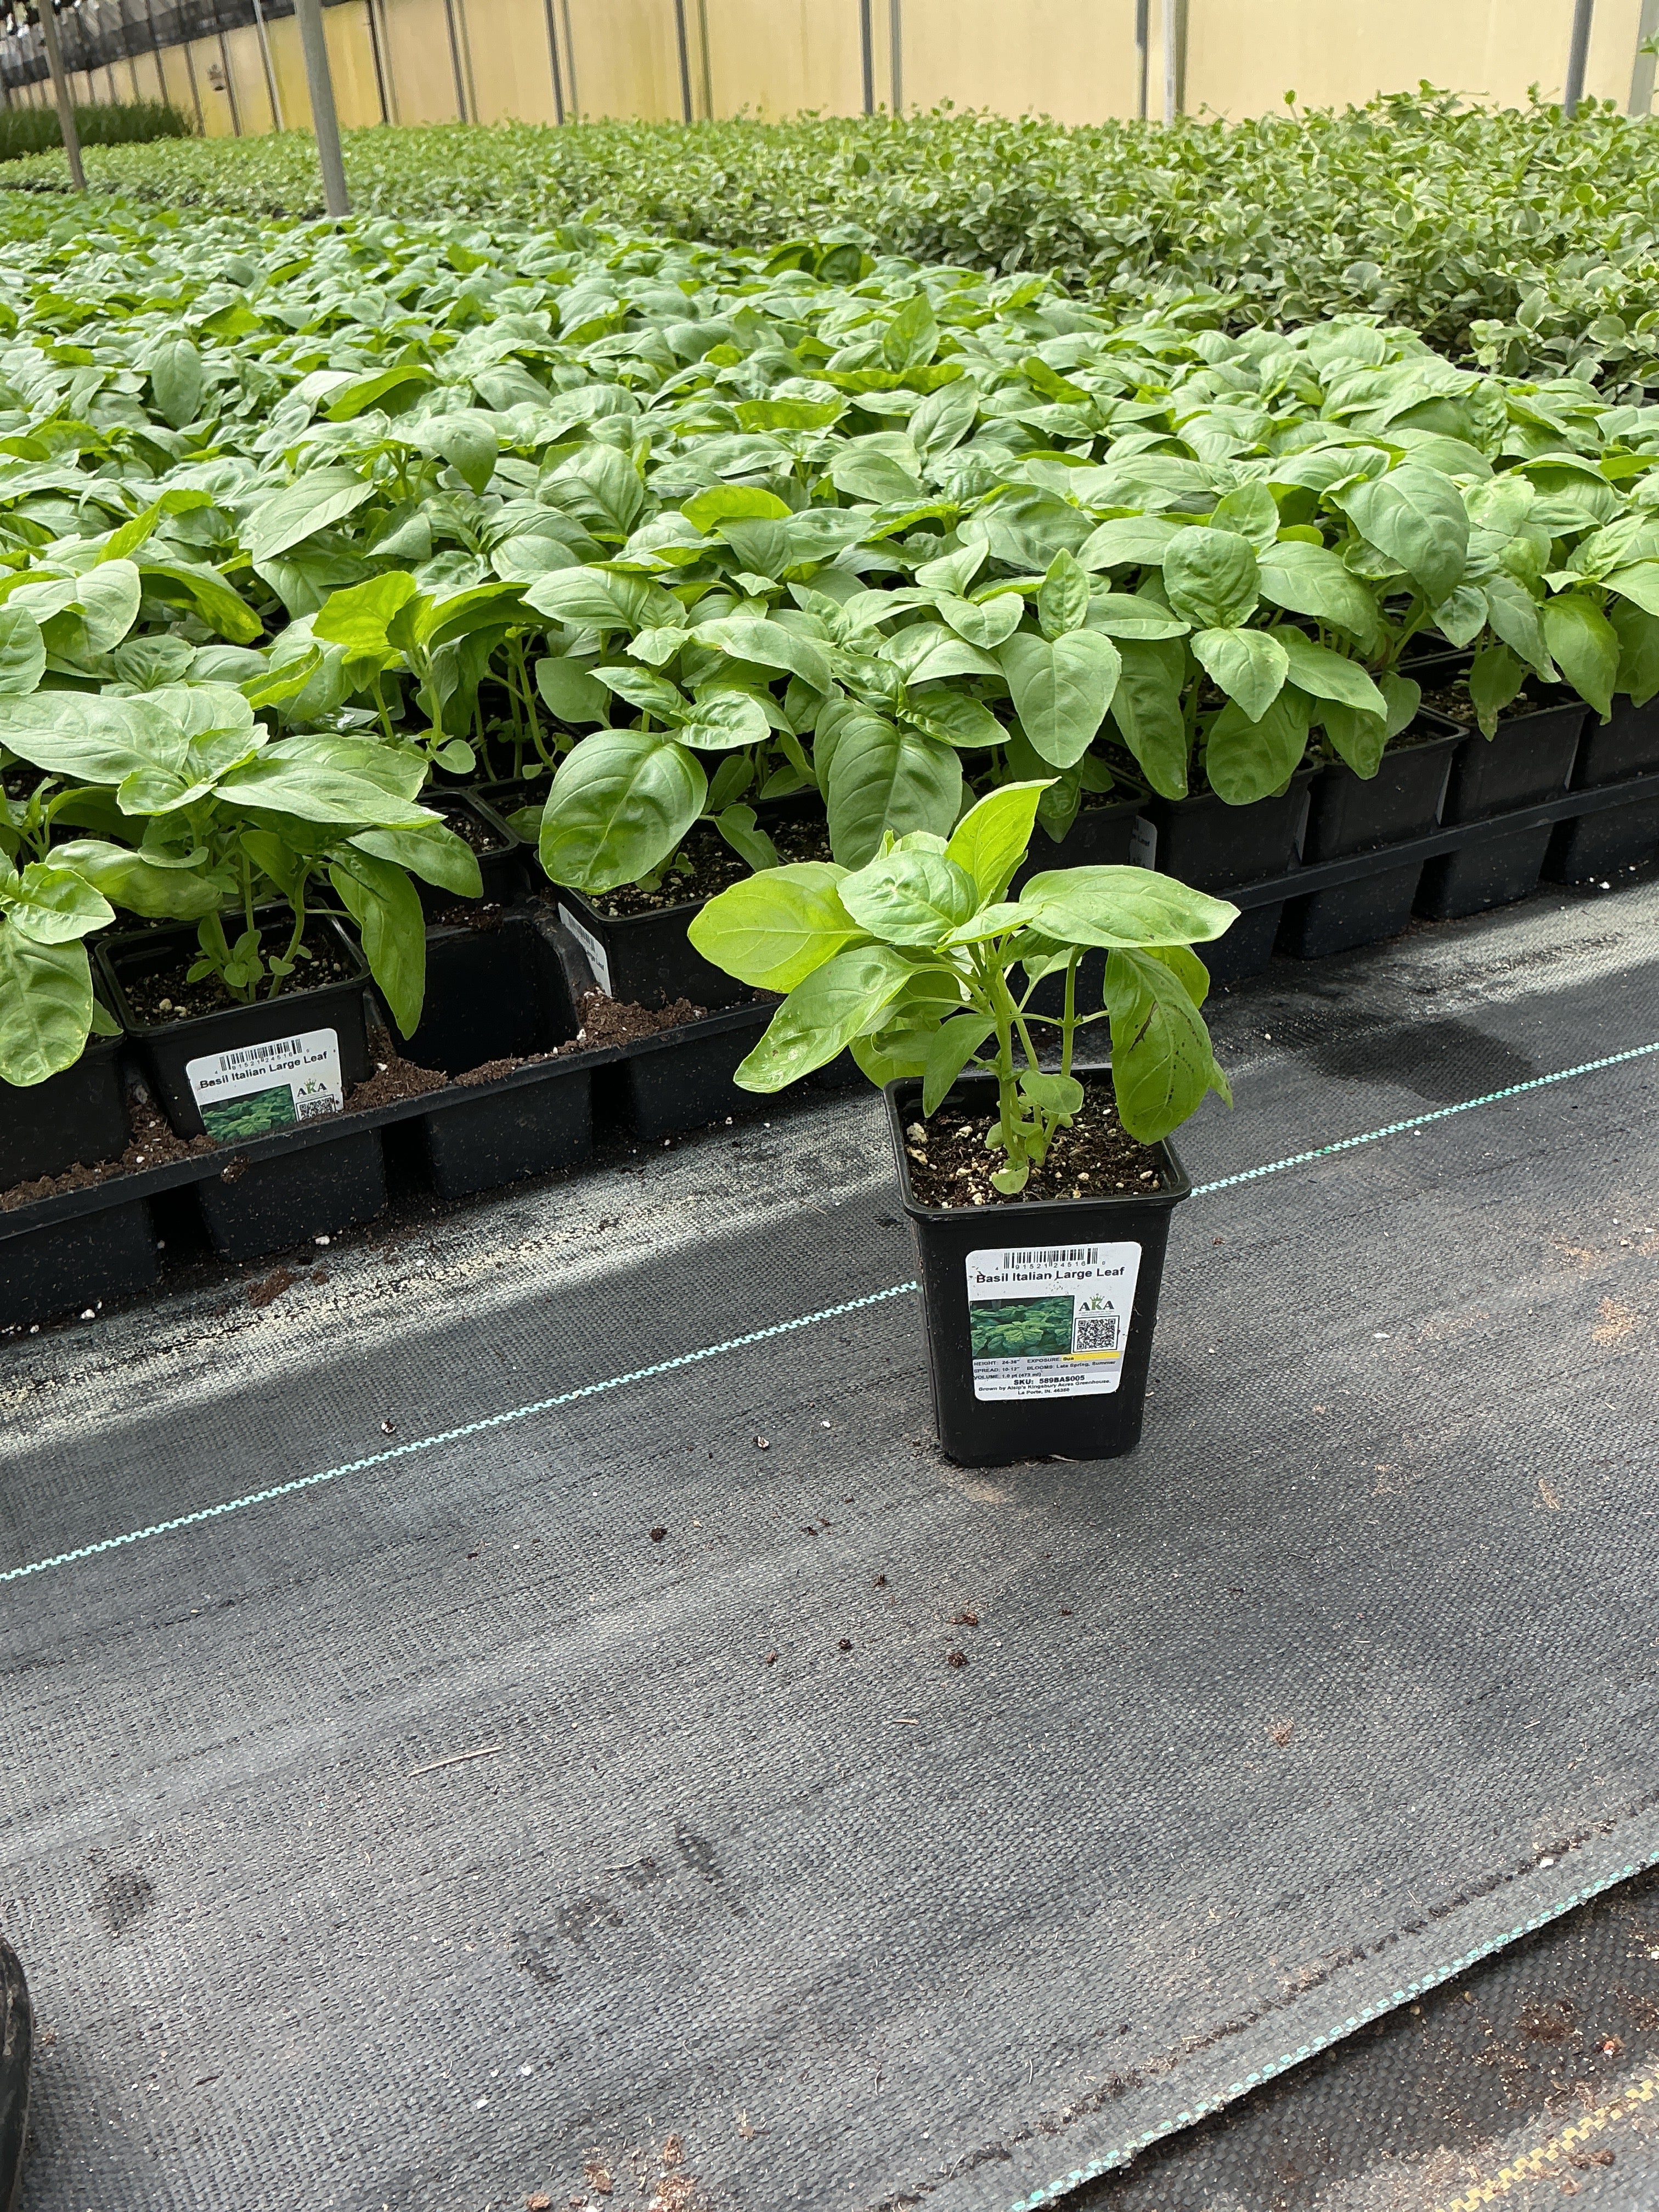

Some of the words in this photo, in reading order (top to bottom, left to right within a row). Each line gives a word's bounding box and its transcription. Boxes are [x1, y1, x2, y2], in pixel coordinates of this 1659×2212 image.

[200, 1074, 229, 1089] Basil
[231, 1067, 266, 1081] Italian
[269, 1059, 301, 1073] Large
[303, 1051, 328, 1064] Leaf
[297, 1082, 328, 1097] AKA
[977, 1273, 1008, 1283] Basil
[1012, 1271, 1052, 1282] Italian
[1056, 1270, 1093, 1280] Large
[1096, 1266, 1125, 1277] Leaf
[1078, 1298, 1115, 1312] AKA
